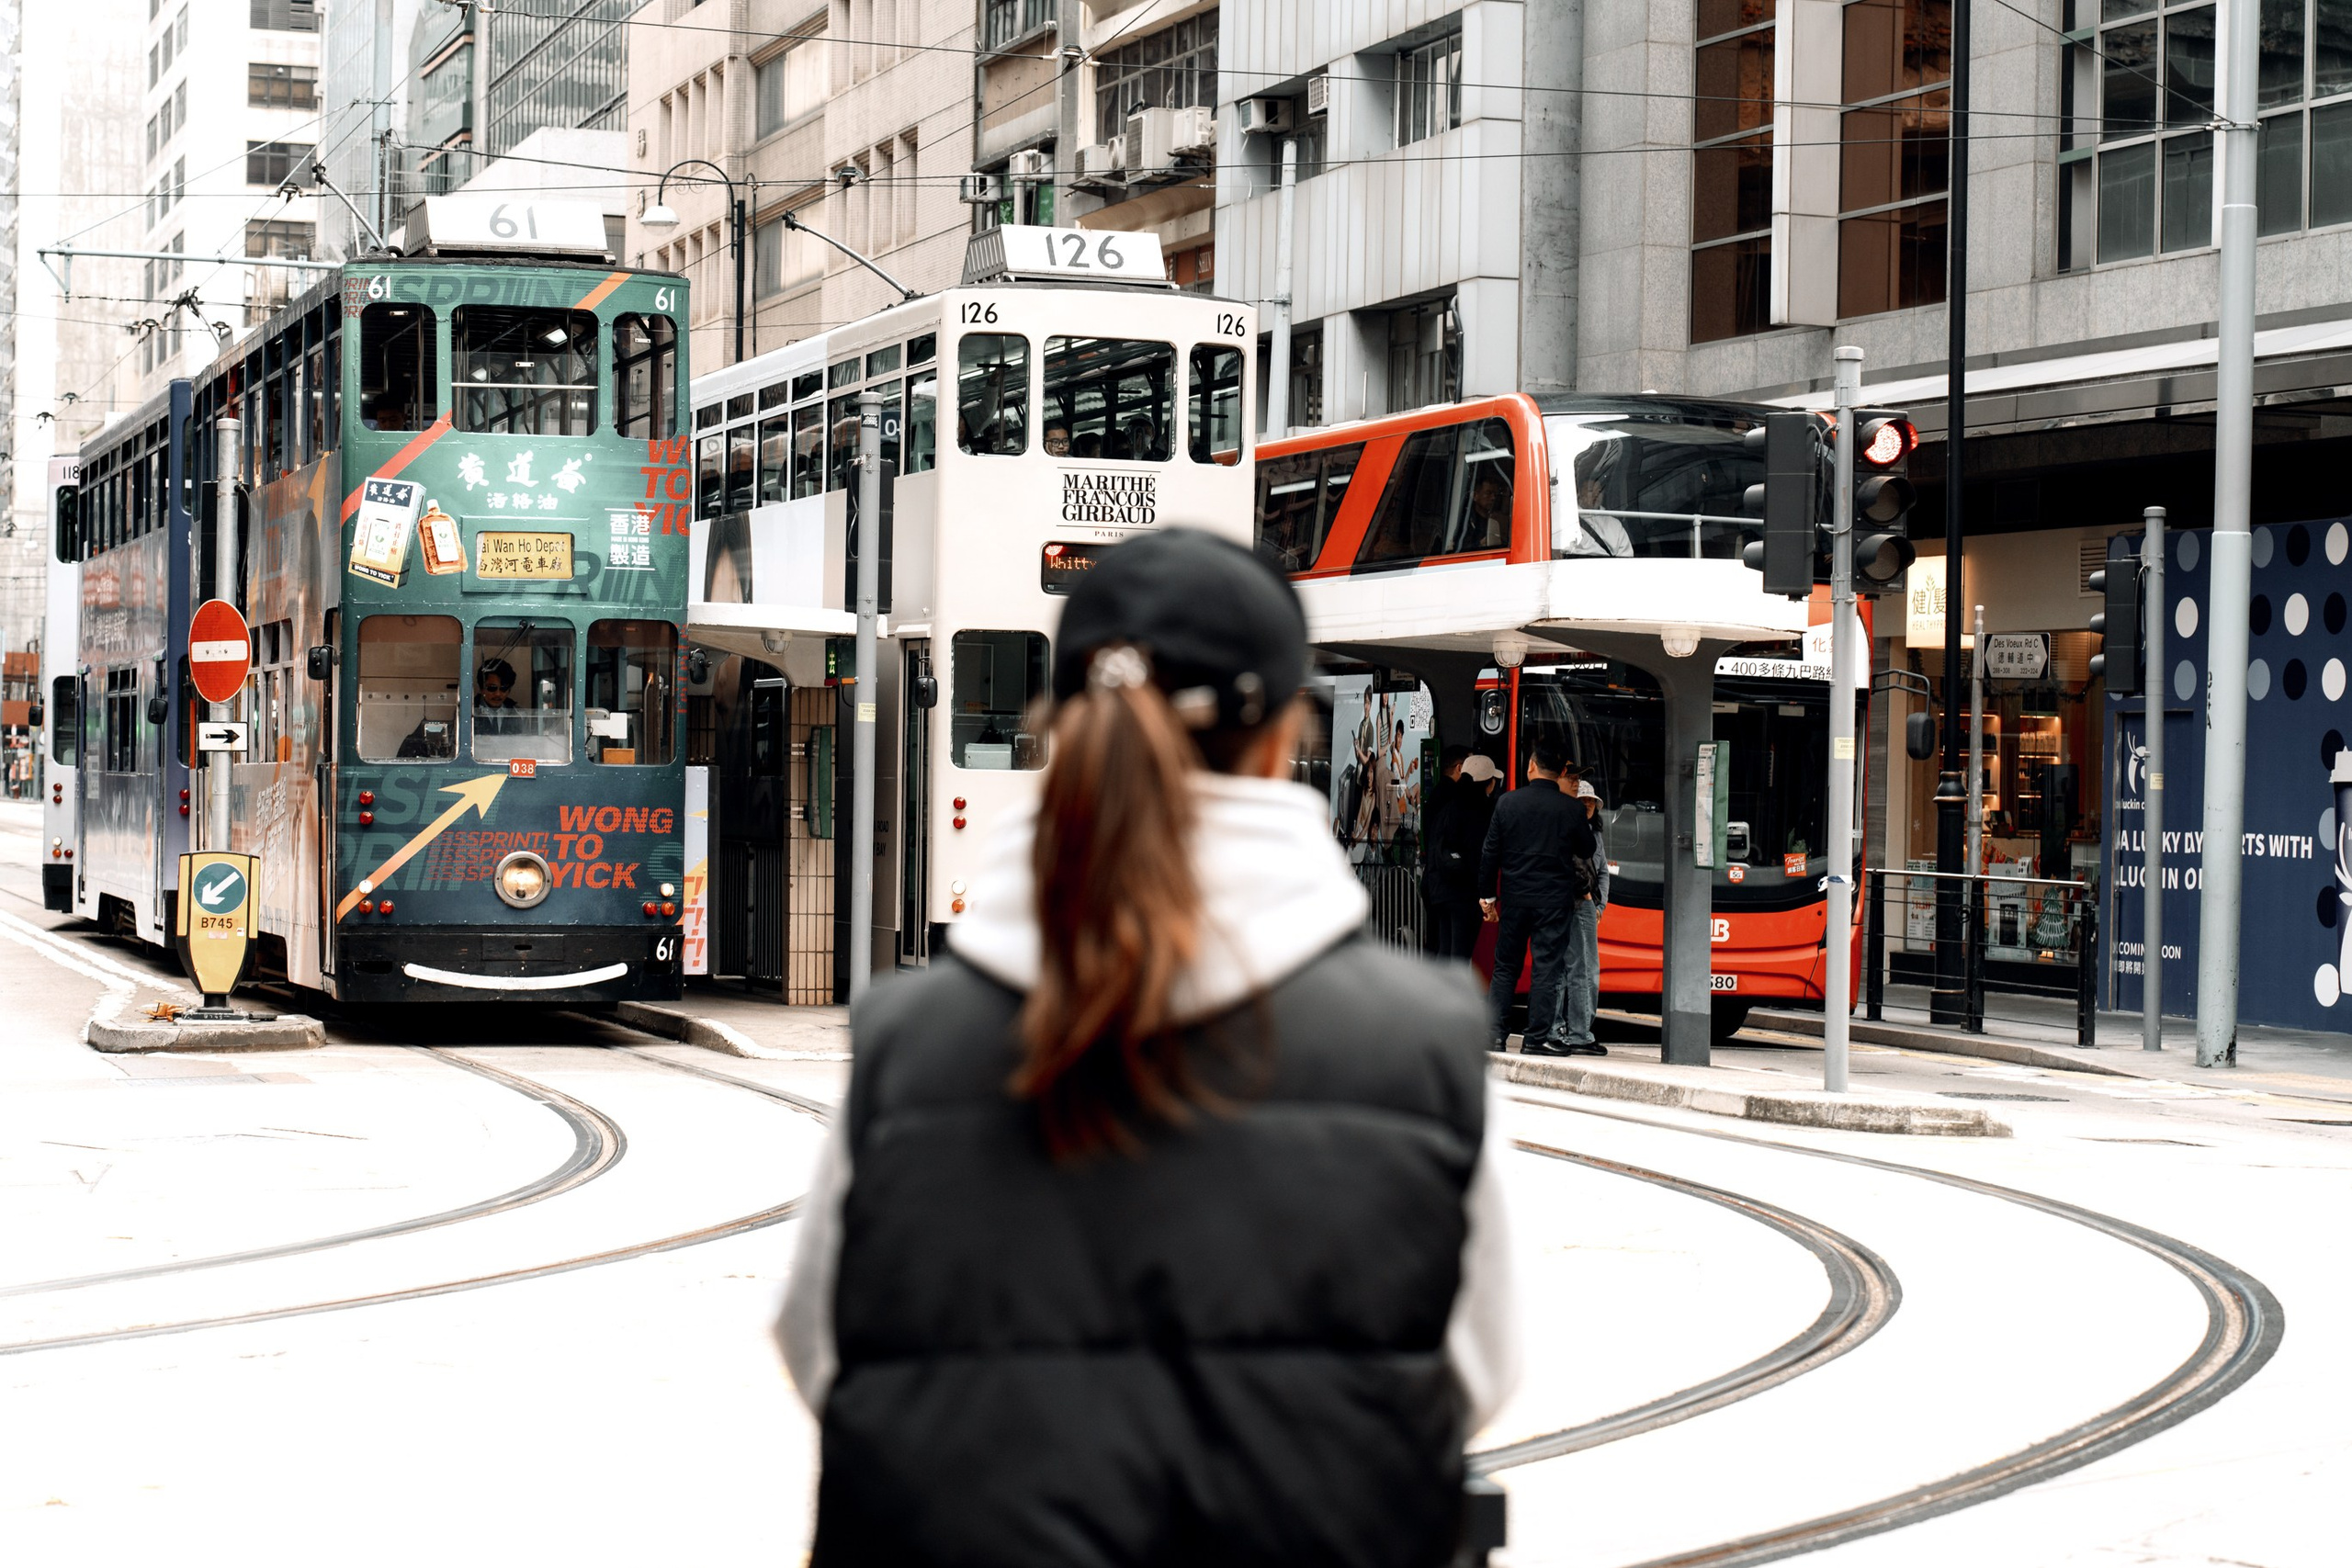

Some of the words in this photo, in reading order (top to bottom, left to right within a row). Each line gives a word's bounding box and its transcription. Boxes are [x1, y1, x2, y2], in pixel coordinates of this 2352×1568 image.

[489, 203, 538, 240] 61
[1046, 232, 1125, 269] 126
[368, 276, 391, 299] 61
[654, 287, 675, 312] 61
[961, 301, 999, 324] 126
[1216, 312, 1246, 337] 126
[62, 465, 80, 479] 118
[1062, 473, 1157, 492] MARITHÉ
[609, 513, 650, 536] 香港
[1062, 504, 1157, 525] GIRBAUD
[493, 538, 514, 553] Wan
[518, 538, 532, 553] Ho
[536, 538, 565, 554] Depot
[609, 543, 650, 566] 製造
[1994, 638, 2005, 649] Des
[2007, 638, 2023, 649] Voeux
[2024, 638, 2032, 649] Rd
[2033, 638, 2039, 649] C
[511, 762, 535, 774] 038
[559, 805, 674, 834] WONG
[552, 833, 605, 861] TO
[2120, 829, 2130, 852] A
[2132, 830, 2181, 853] LUKY
[2268, 834, 2312, 860] WITH
[548, 862, 641, 889] YICK
[2120, 865, 2178, 890] LUCIN
[200, 917, 233, 930] B745
[656, 937, 674, 962] 61
[2118, 942, 2145, 956] COMIN
[2161, 944, 2182, 960] OON
